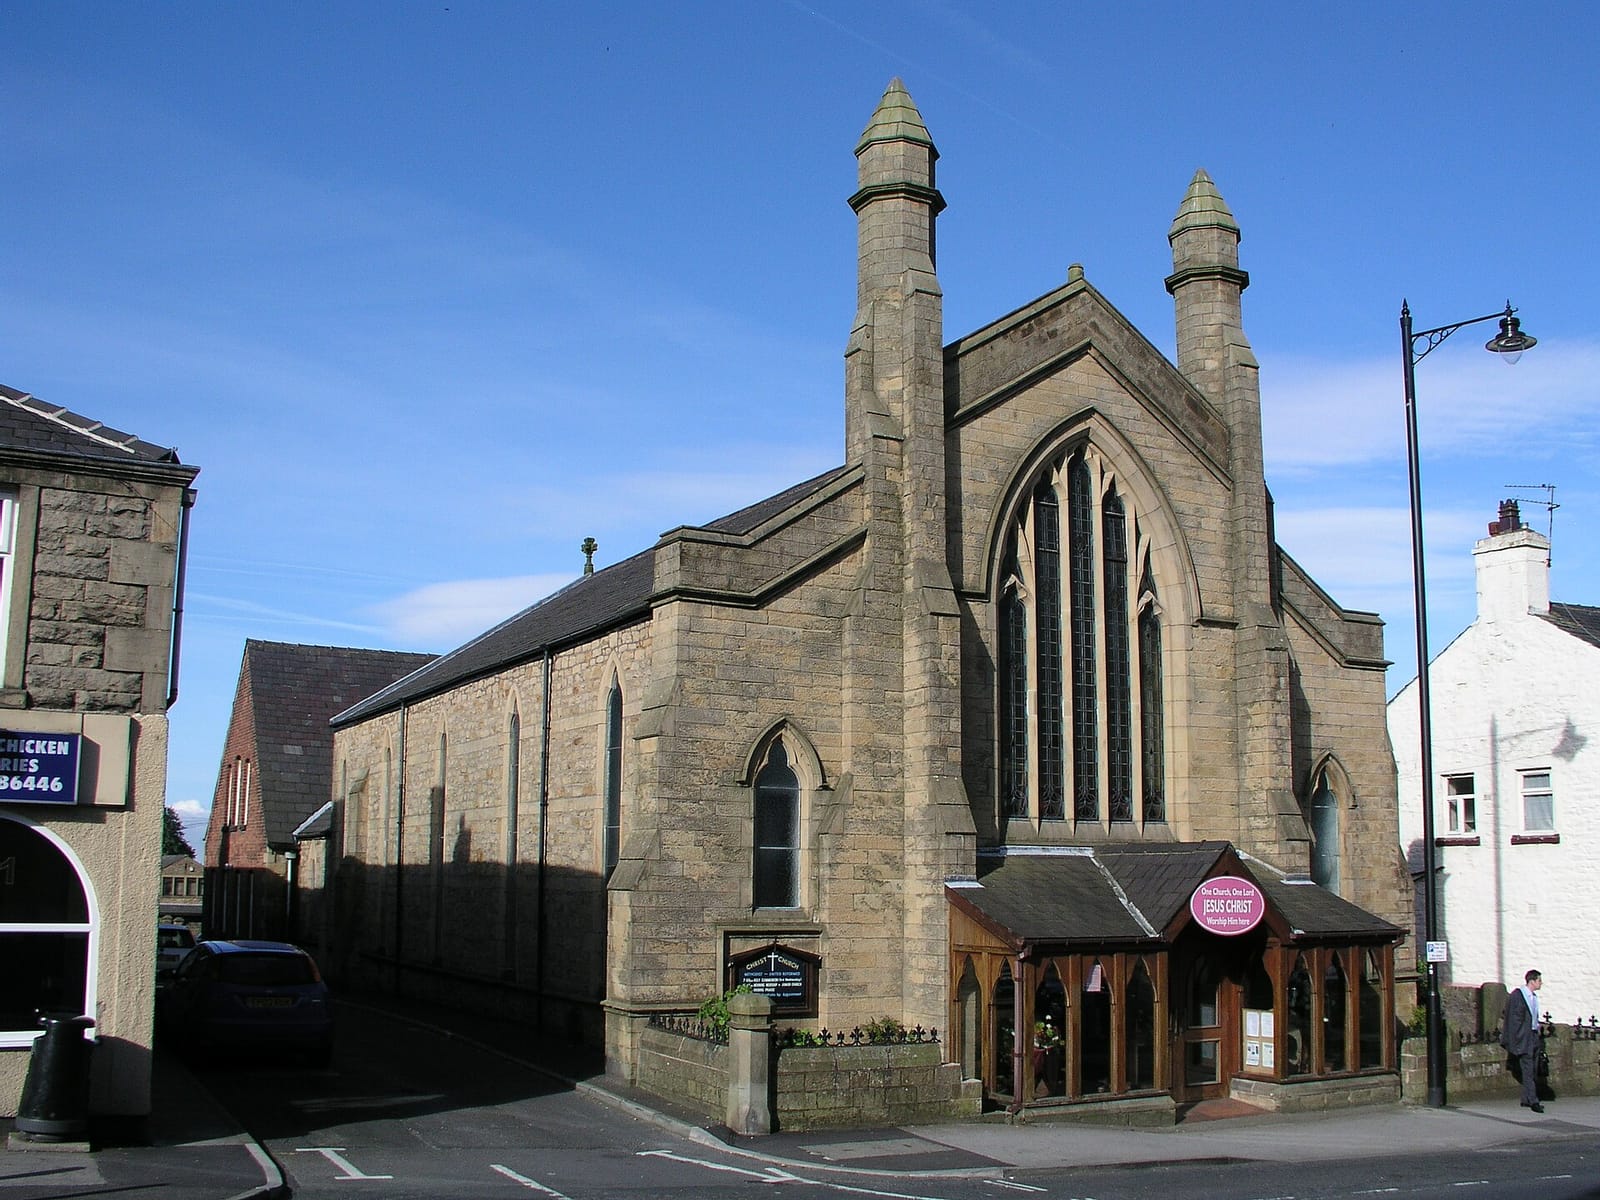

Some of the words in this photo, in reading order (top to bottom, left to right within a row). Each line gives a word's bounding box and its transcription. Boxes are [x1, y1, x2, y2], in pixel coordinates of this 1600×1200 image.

[0, 740, 69, 755] CHICKEN
[1213, 888, 1231, 896] Church,
[1232, 888, 1242, 896] One
[1203, 899, 1224, 915] JESUS
[1226, 899, 1252, 913] CHRIST
[1207, 917, 1227, 927] Worship
[1228, 917, 1238, 925] Him
[1239, 917, 1250, 925] here
[746, 957, 767, 970] CHRIST
[778, 956, 800, 969] CHURCH
